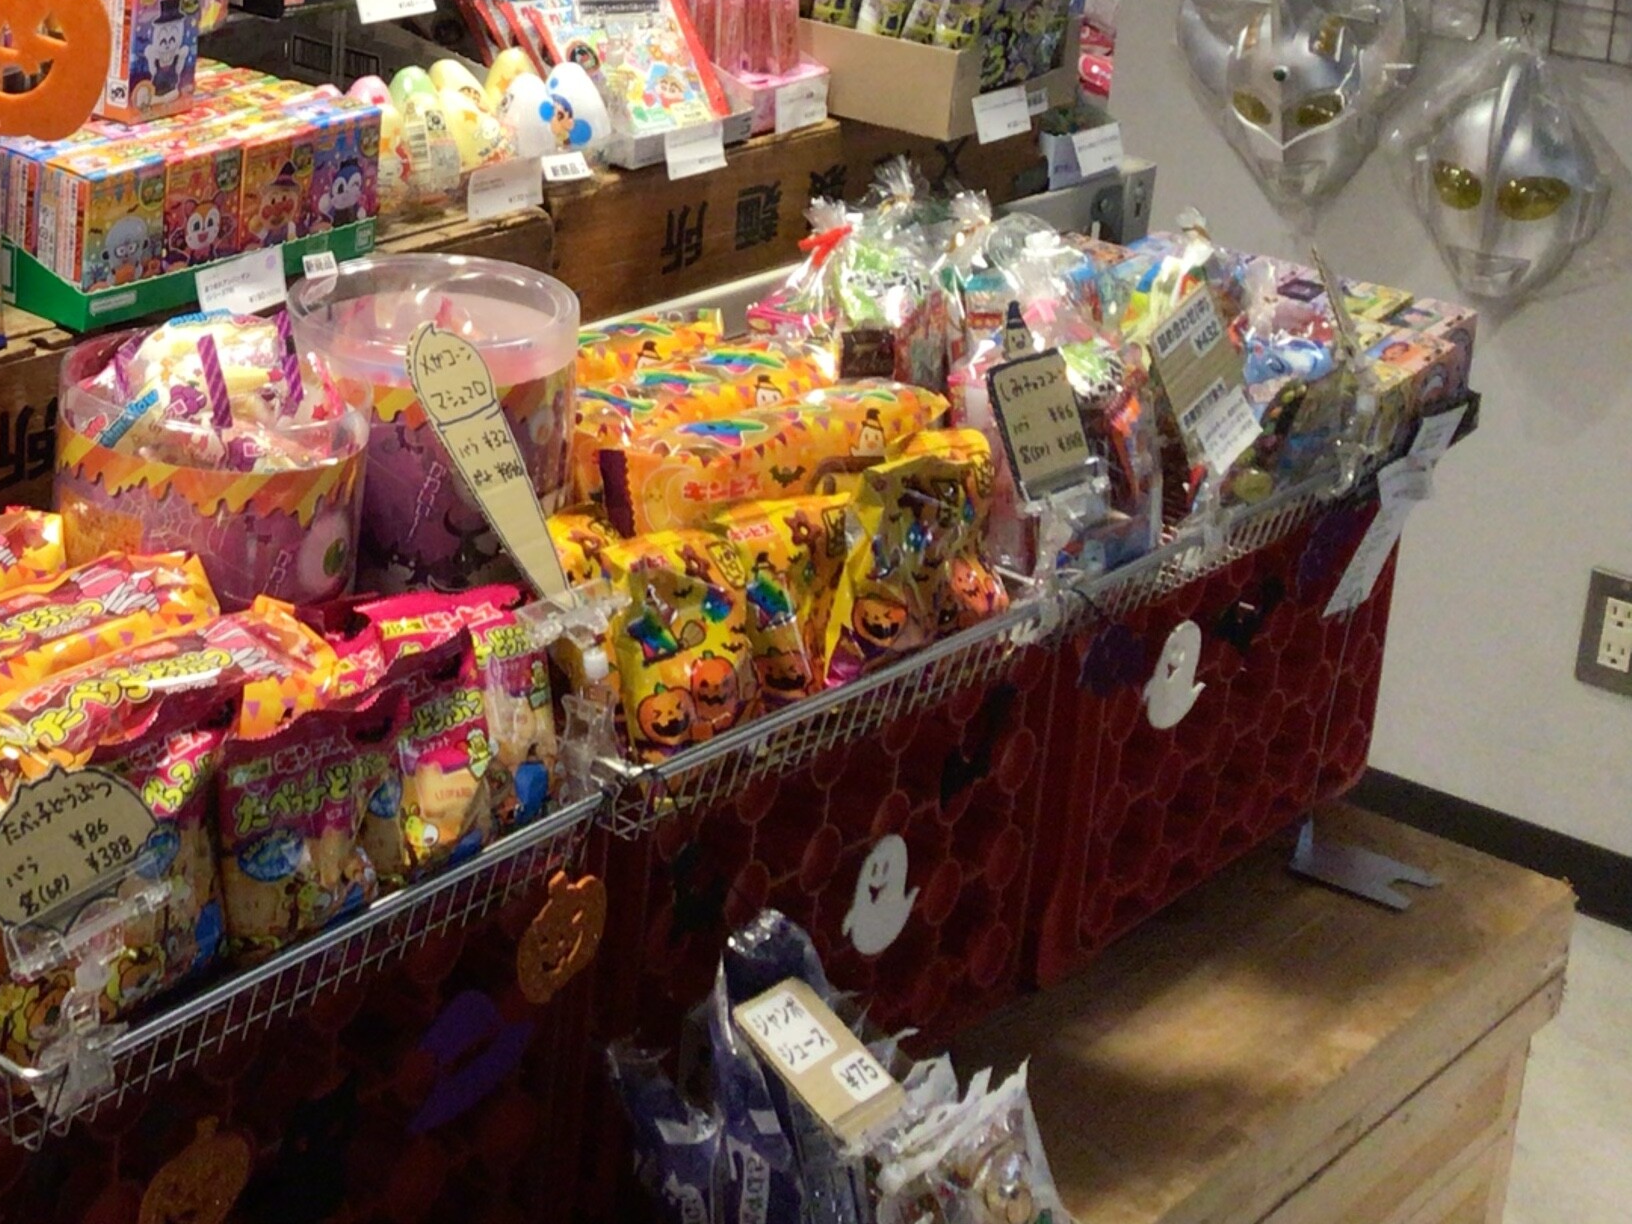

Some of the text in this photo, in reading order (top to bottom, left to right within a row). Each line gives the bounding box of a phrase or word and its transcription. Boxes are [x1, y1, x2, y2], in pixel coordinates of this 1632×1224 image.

[69, 818, 110, 850] ¥86
[85, 835, 133, 874] ¥388
[6, 856, 39, 888] バラ
[839, 1056, 880, 1090] ¥75
